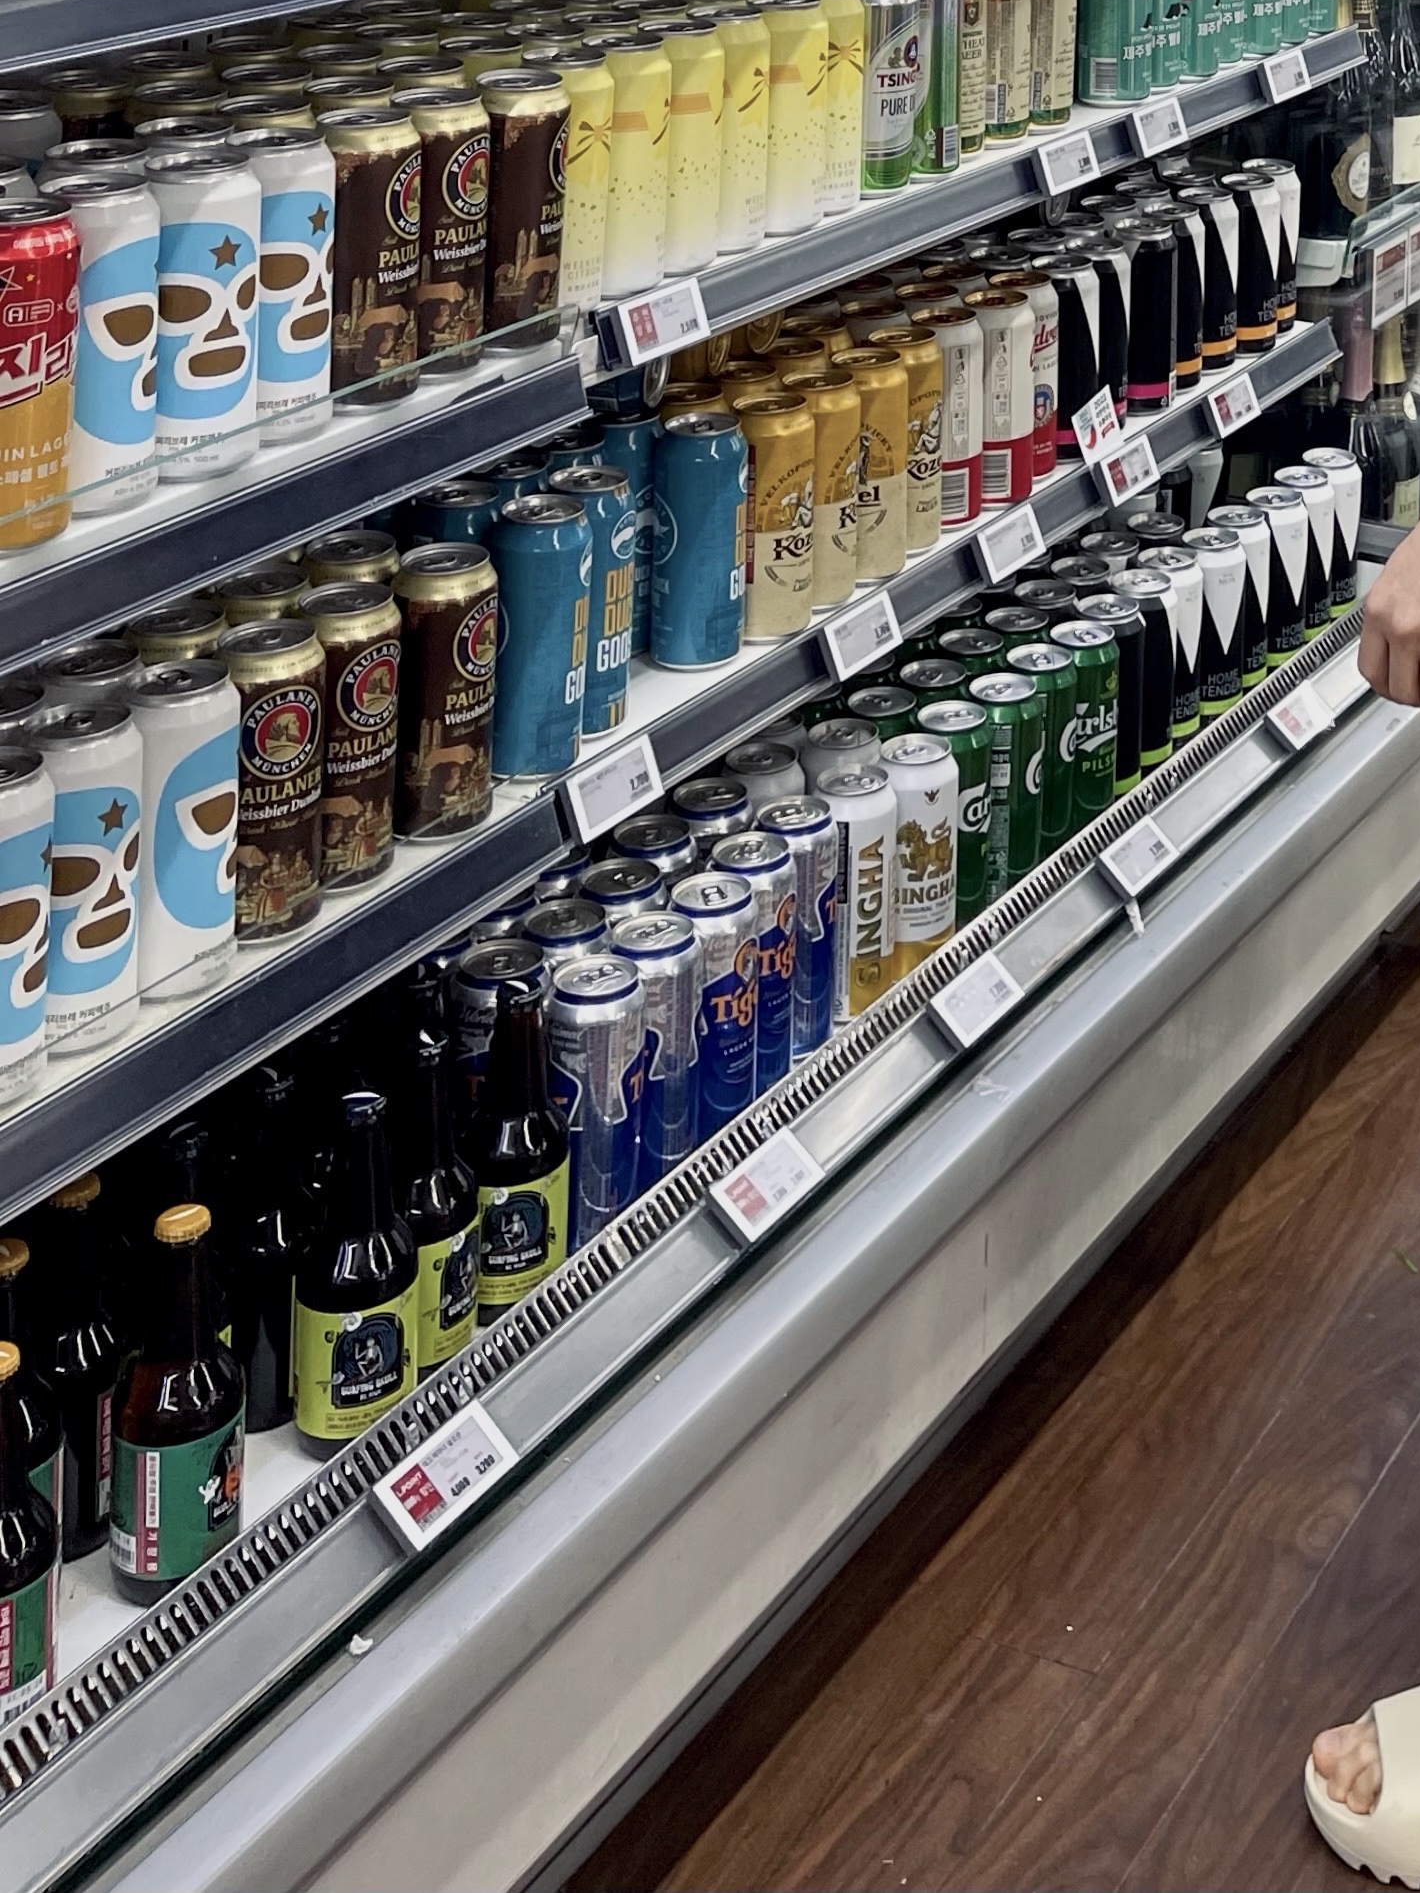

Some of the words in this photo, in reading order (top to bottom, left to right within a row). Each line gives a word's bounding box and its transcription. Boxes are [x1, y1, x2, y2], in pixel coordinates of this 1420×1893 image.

[880, 97, 908, 118] PURE
[1207, 667, 1240, 686] HOME
[1202, 680, 1242, 698] TENDER
[856, 834, 885, 989] SINGHA
